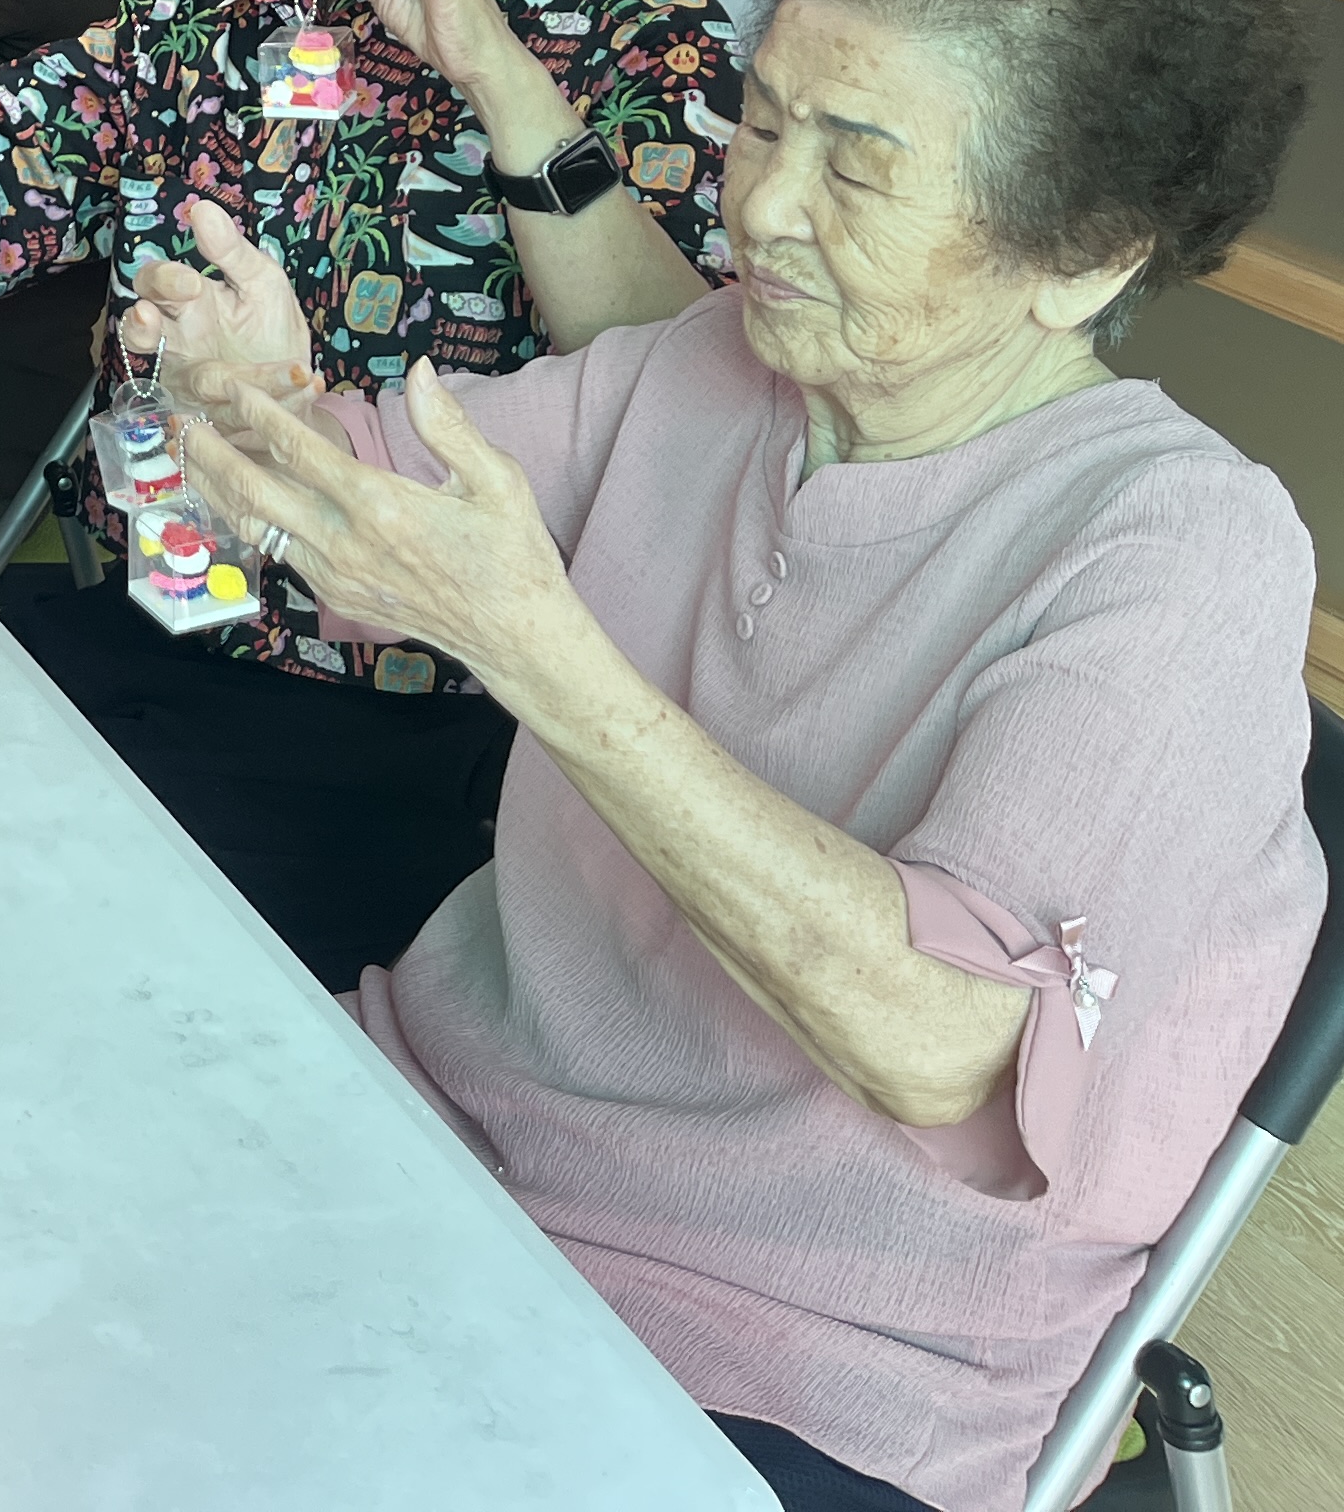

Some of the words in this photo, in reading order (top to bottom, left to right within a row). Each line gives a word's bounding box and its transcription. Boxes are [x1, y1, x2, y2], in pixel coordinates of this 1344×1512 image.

[355, 276, 398, 304] WA
[351, 299, 393, 330] VE
[429, 317, 503, 344] summer
[426, 338, 501, 365] summer
